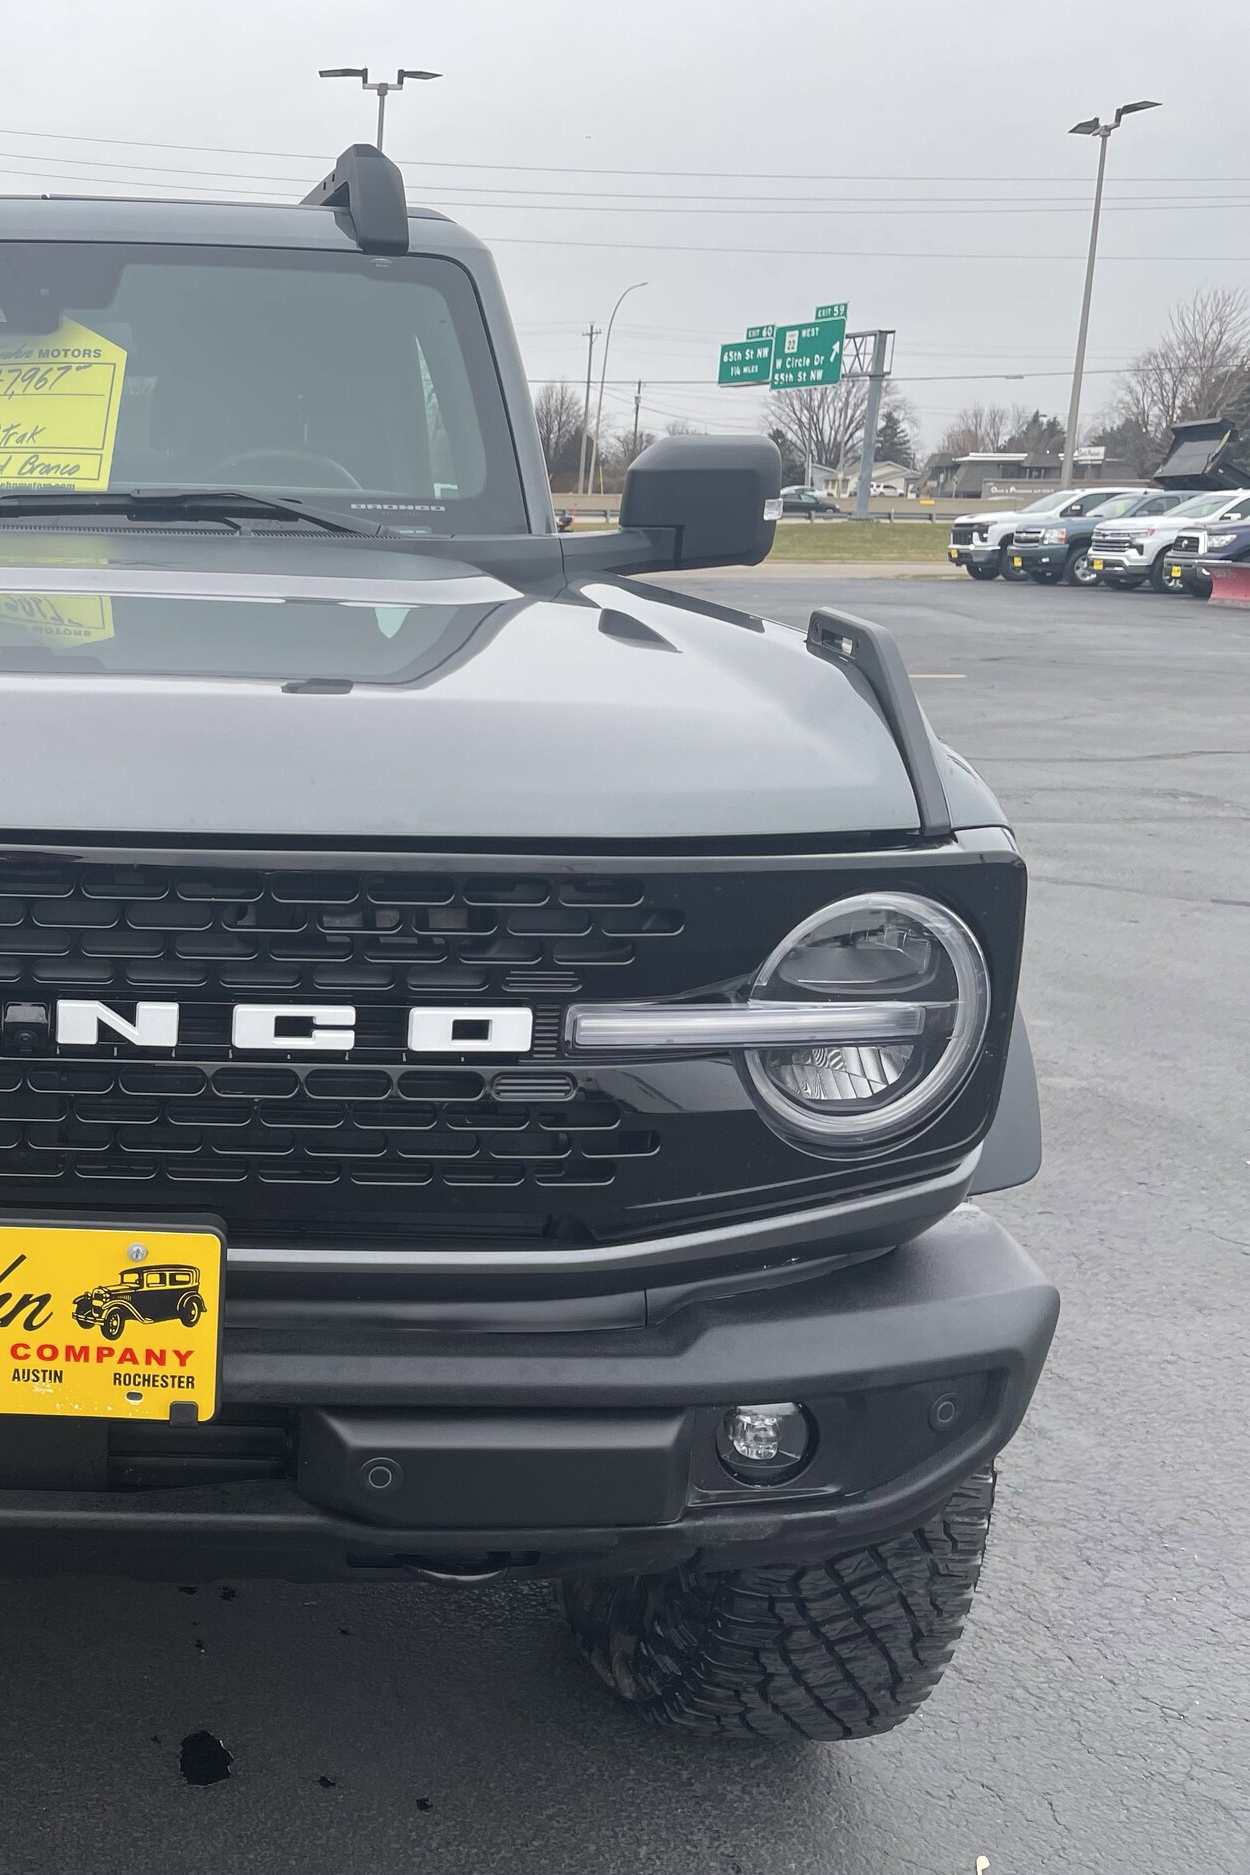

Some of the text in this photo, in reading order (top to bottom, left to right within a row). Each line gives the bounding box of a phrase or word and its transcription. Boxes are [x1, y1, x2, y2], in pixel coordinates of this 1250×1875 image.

[817, 305, 845, 318] EXIT 59
[762, 326, 773, 337] 60
[801, 327, 820, 338] WEST
[787, 339, 796, 350] 22
[38, 348, 102, 359] MOTORS
[723, 347, 769, 363] 65th St NW
[775, 354, 825, 370] W Circle Dr
[743, 364, 758, 374] MILES
[774, 369, 823, 385] 55th St NW
[350, 503, 446, 512] BRONCO
[10, 1343, 196, 1367] COMPANY
[12, 1368, 63, 1384] AUSTIN
[113, 1372, 196, 1389] ROCHESTER
